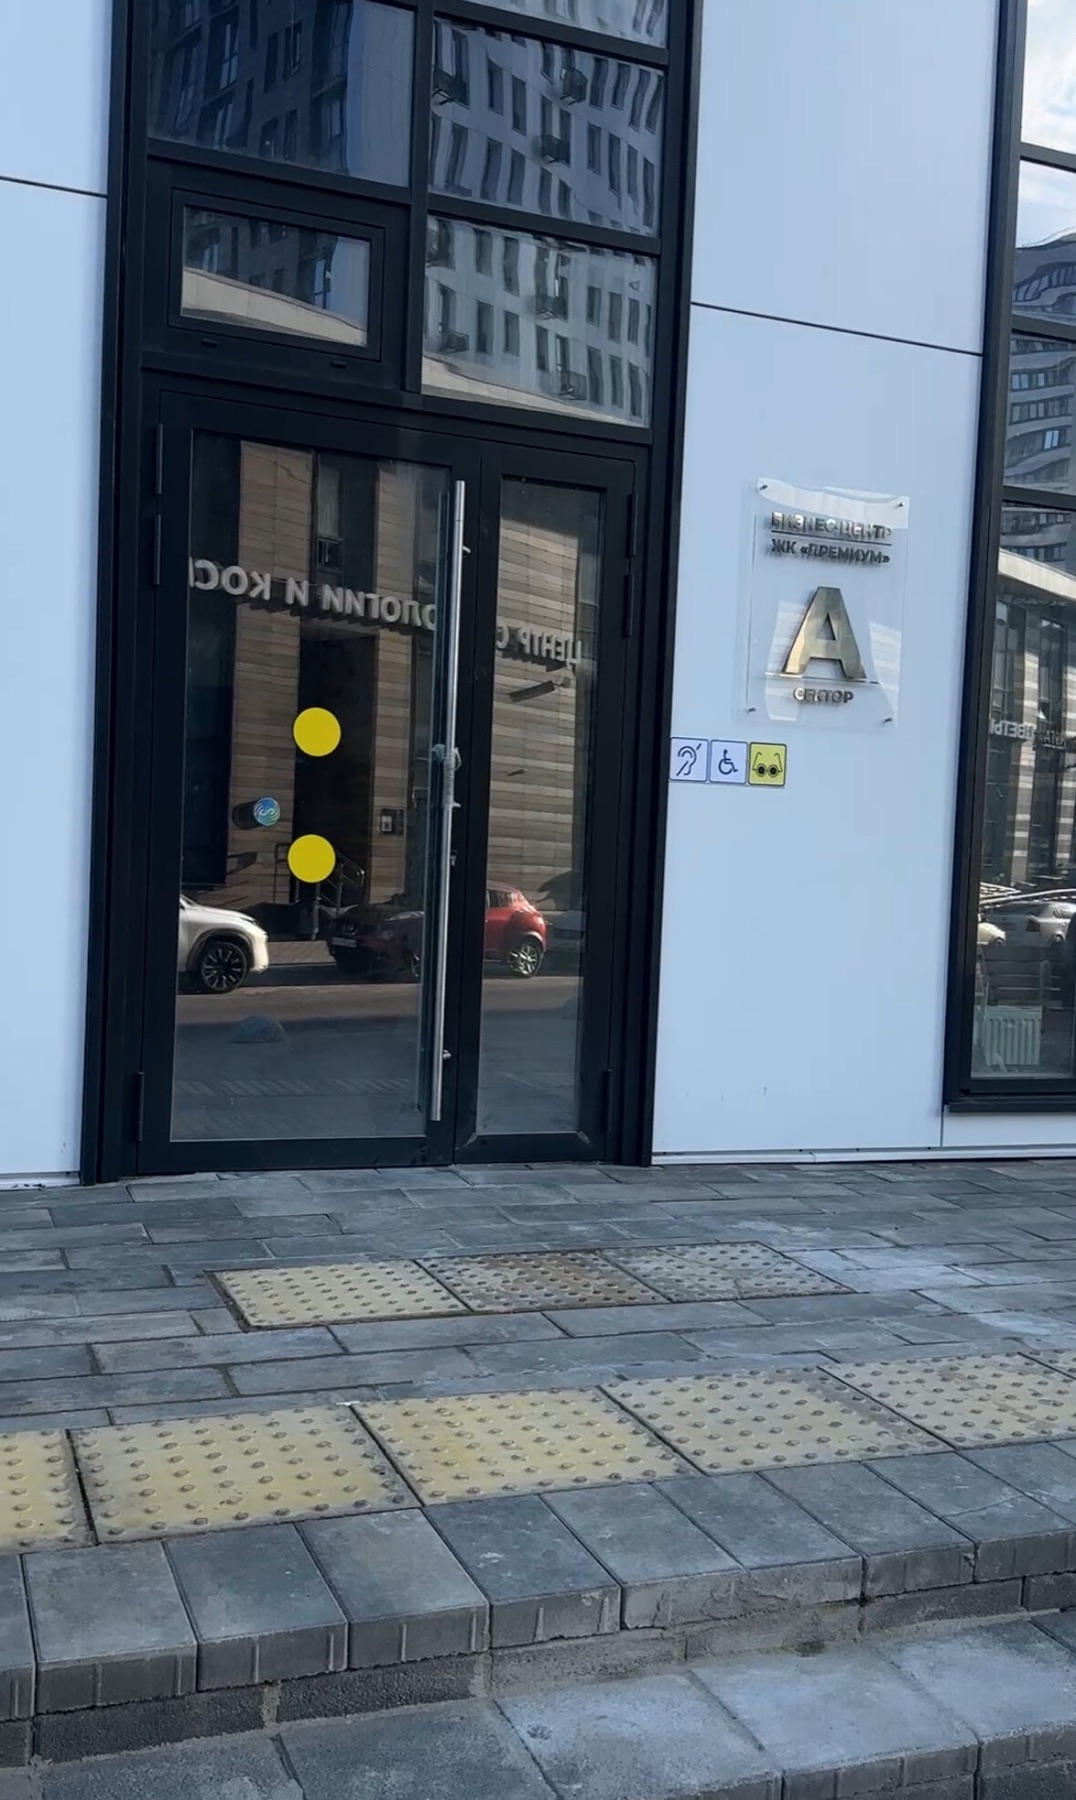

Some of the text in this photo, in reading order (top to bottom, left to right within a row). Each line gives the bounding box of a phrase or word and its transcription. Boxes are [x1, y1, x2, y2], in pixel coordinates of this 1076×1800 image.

[771, 538, 891, 564] ЖК «ПРЕМИУМ»
[782, 585, 867, 680] А
[793, 687, 855, 704] СЕКТОР
